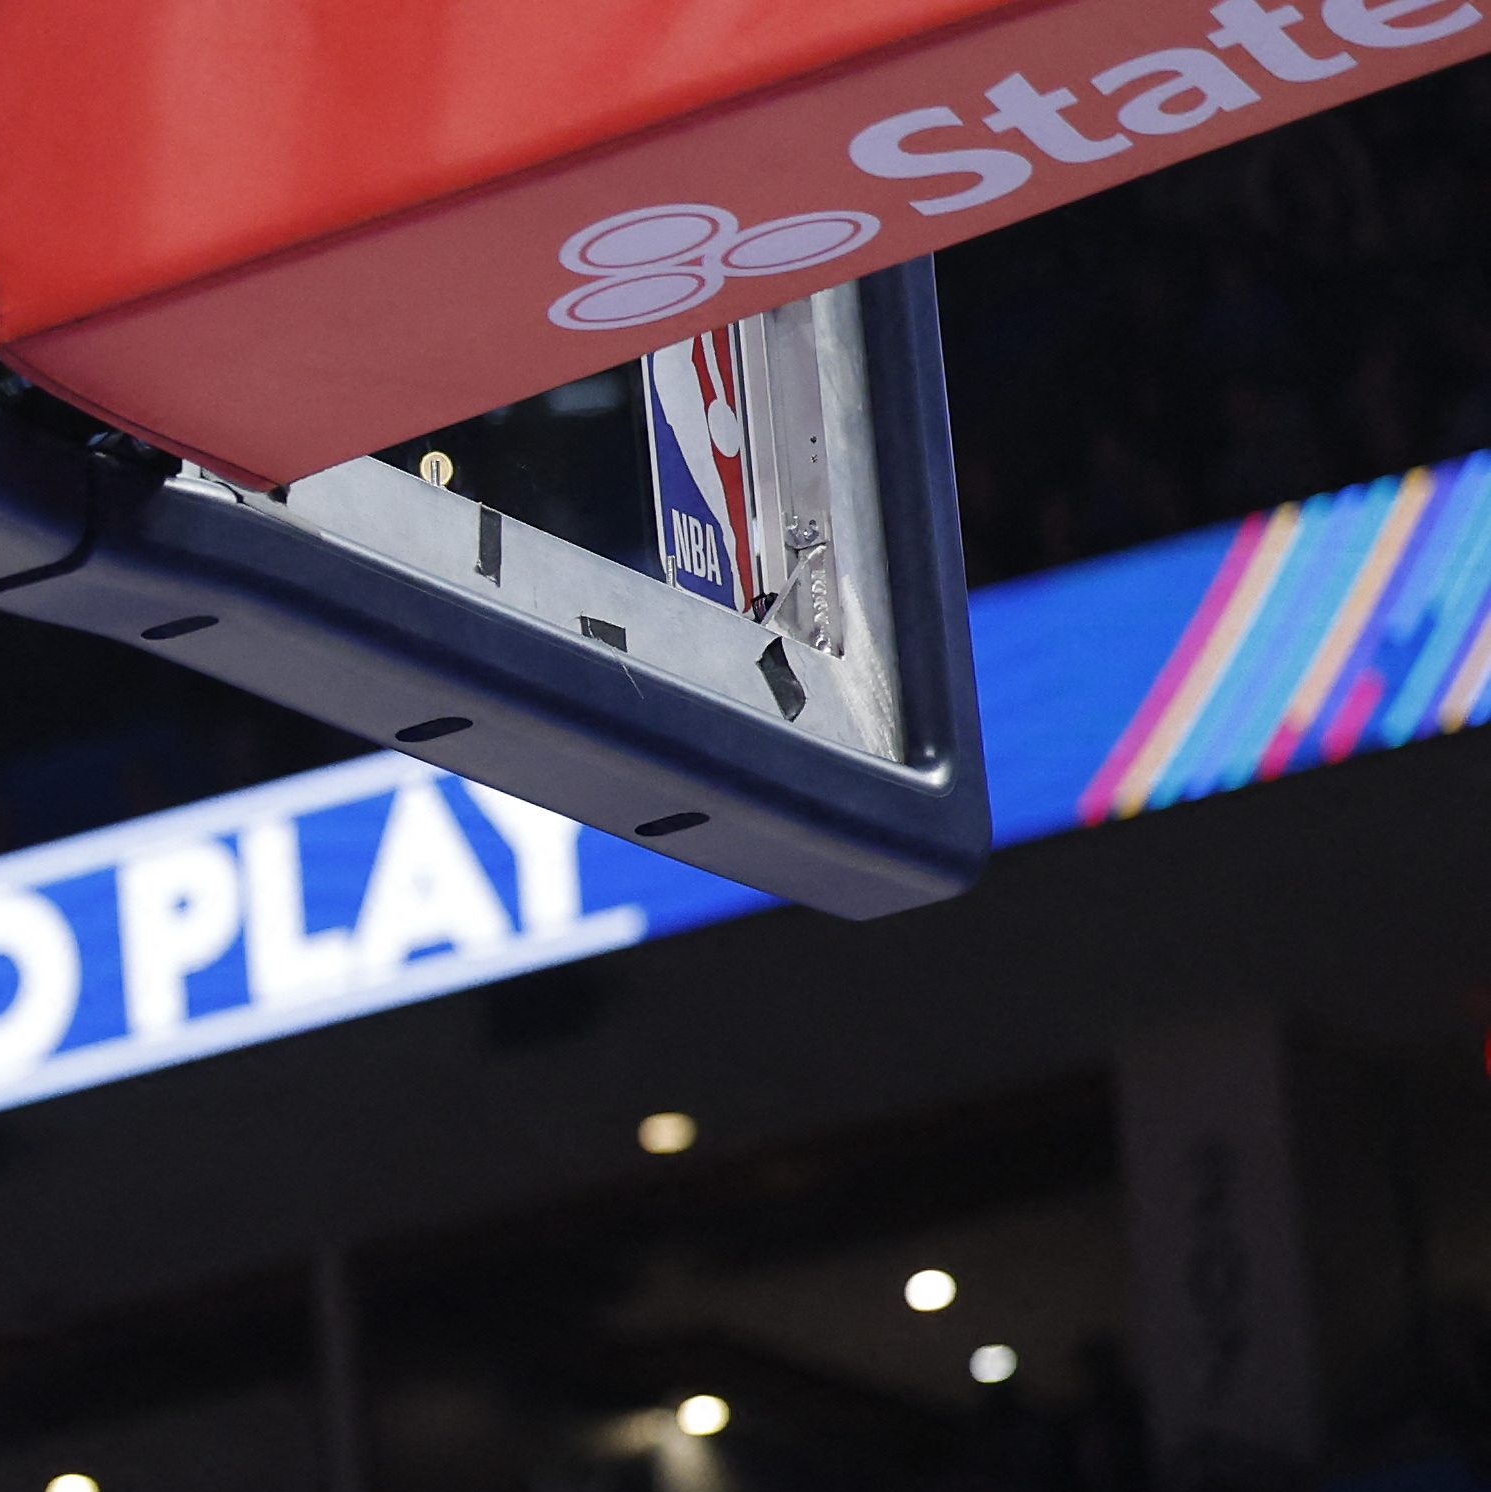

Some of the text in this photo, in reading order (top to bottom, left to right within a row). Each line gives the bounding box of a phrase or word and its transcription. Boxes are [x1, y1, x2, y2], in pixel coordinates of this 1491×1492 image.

[849, 0, 1484, 216] State
[671, 508, 723, 587] NBA
[119, 772, 585, 1038] PLAY
